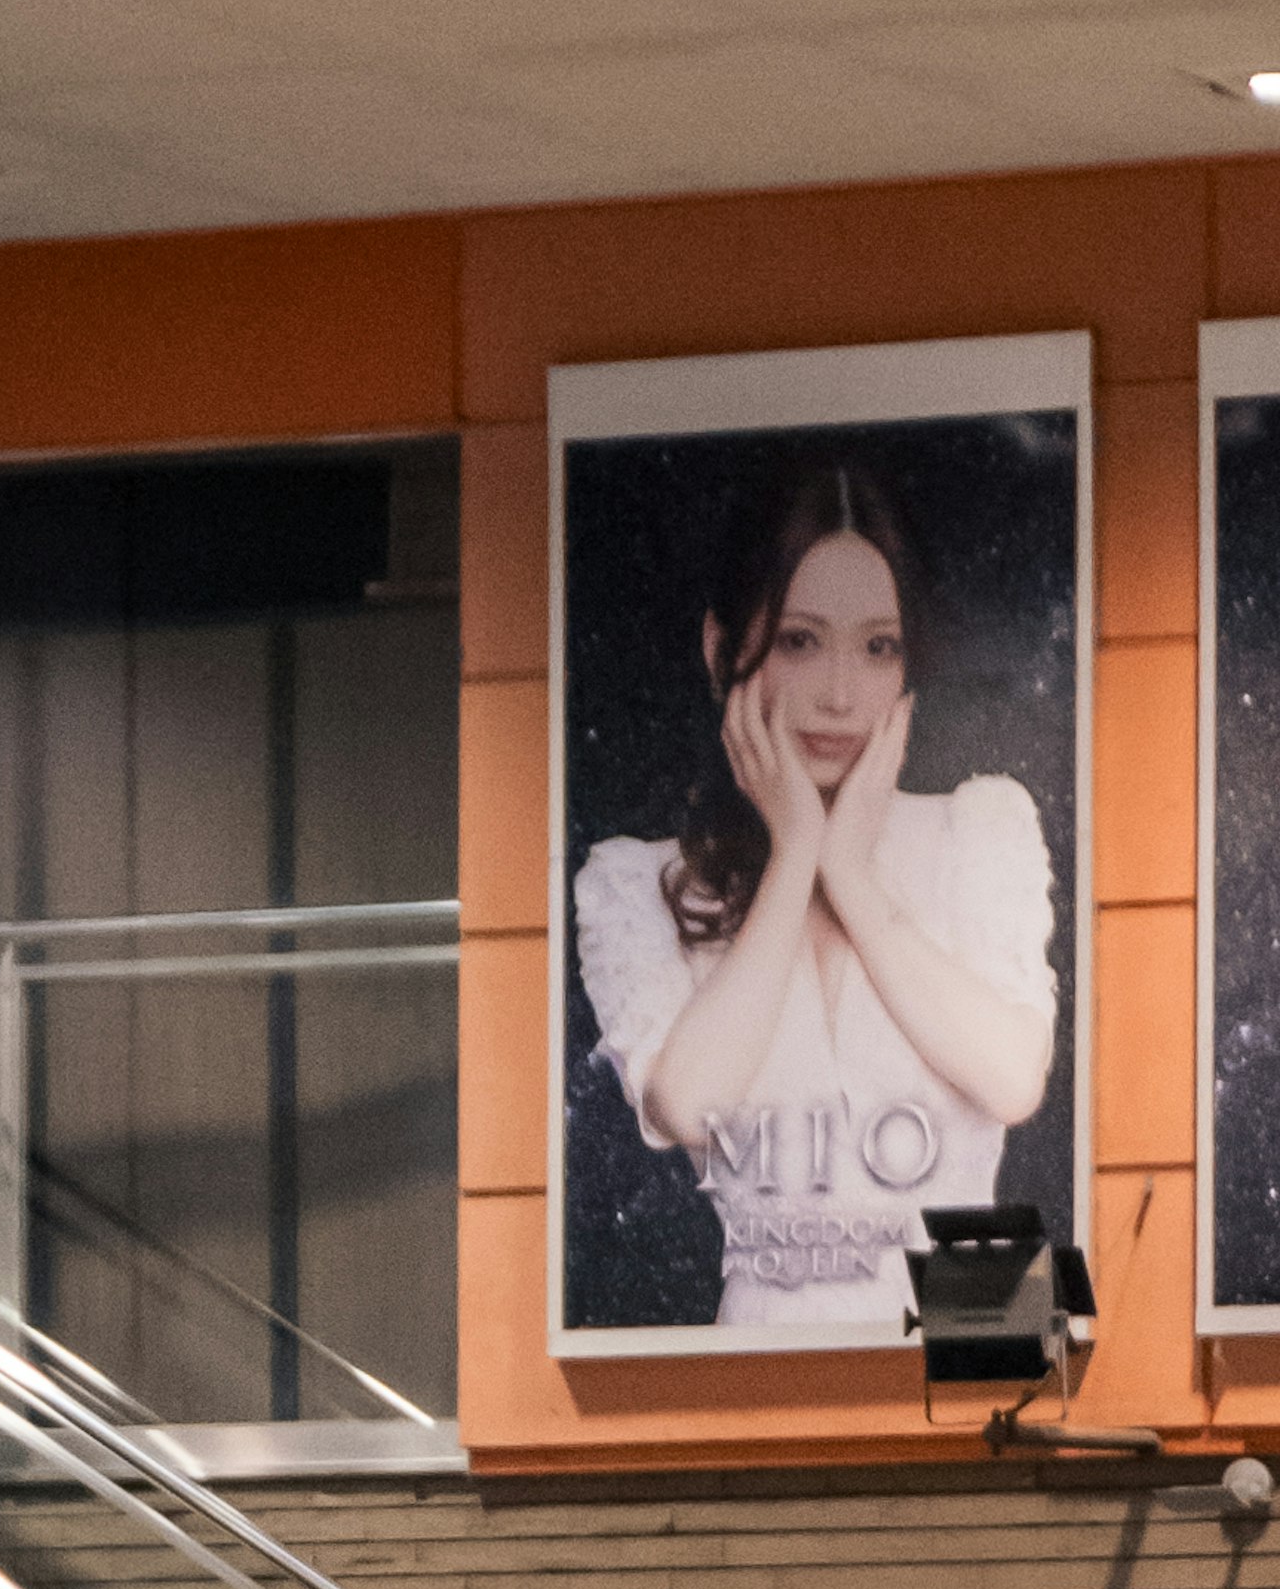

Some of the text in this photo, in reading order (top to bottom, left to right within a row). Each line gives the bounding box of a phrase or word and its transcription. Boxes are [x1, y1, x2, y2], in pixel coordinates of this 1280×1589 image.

[694, 1098, 942, 1196] MIO
[722, 1216, 910, 1252] KINGDOM
[752, 1248, 877, 1288] QUEEN
